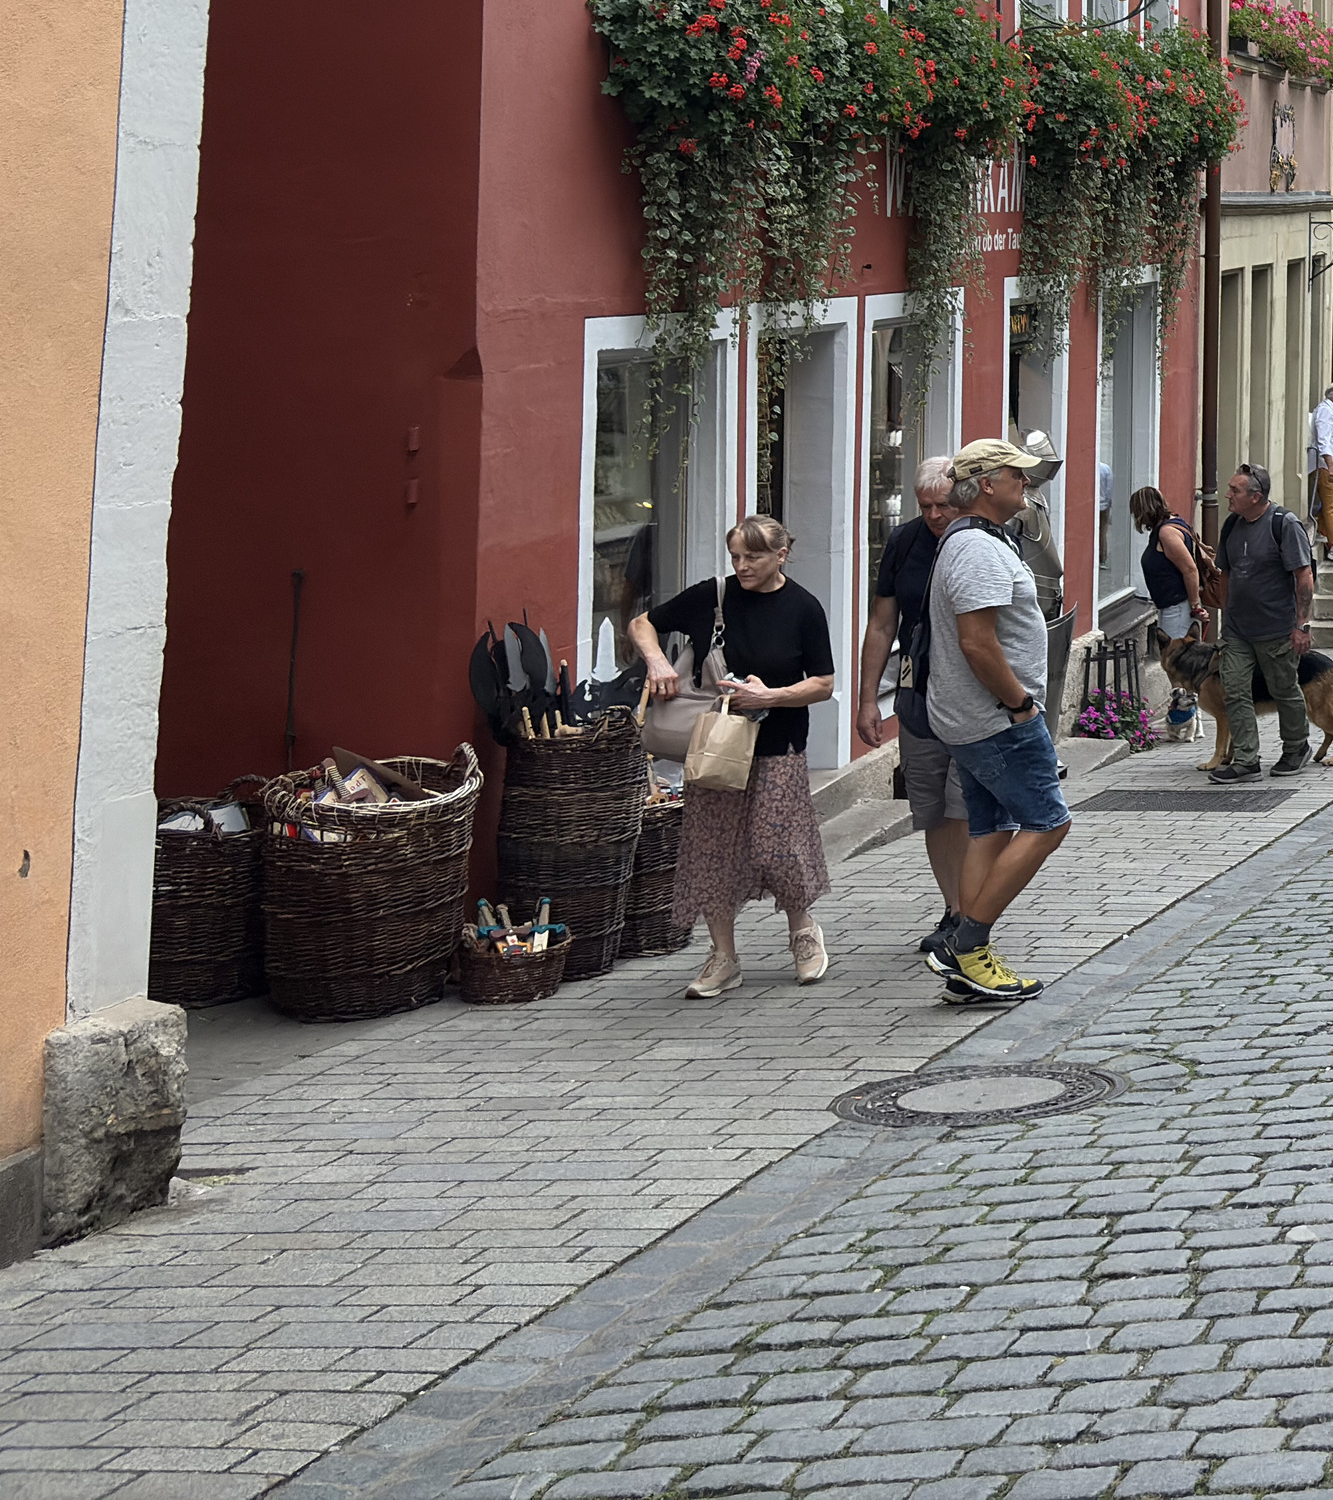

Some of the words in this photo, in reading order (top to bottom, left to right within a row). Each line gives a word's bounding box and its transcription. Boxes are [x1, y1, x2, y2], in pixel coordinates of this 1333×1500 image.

[982, 229, 993, 252] ob
[993, 228, 1006, 251] der
[1007, 227, 1022, 249] Tau
